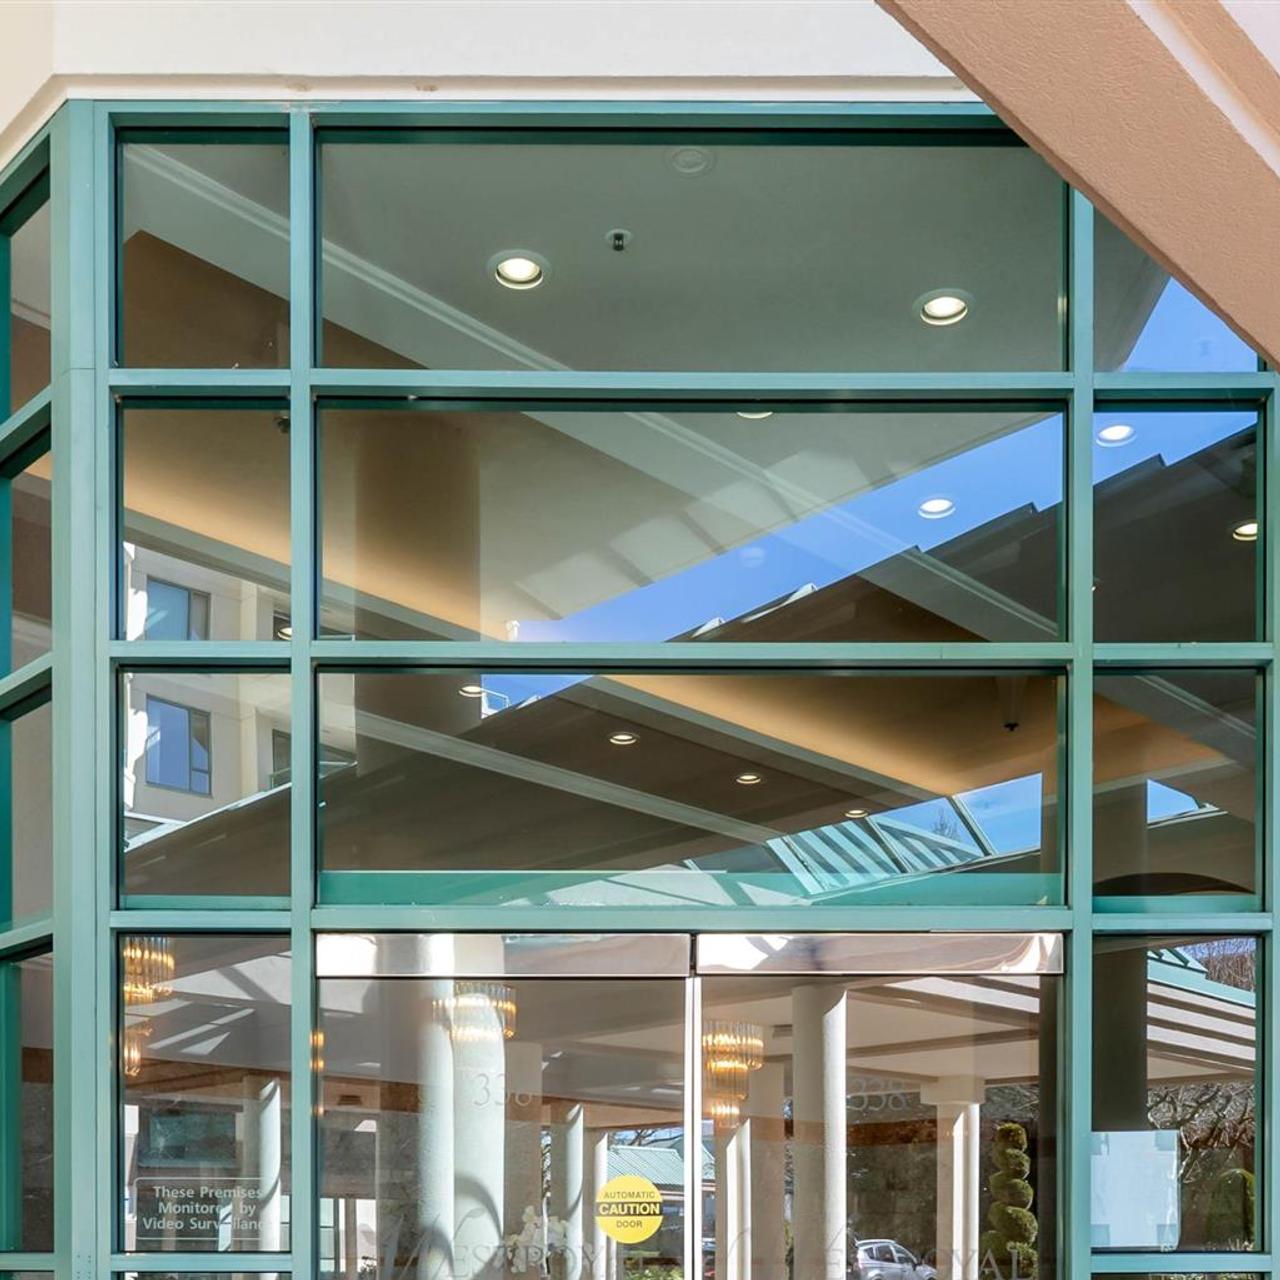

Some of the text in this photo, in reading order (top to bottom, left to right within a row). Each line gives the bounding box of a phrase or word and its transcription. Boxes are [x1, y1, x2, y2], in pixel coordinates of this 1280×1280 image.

[152, 1185, 264, 1199] These Premises
[603, 1191, 656, 1199] AUTOMATIC
[239, 1201, 257, 1217] by
[598, 1202, 661, 1215] CAUTION
[142, 1216, 185, 1230] Video
[616, 1219, 643, 1228] DOOR
